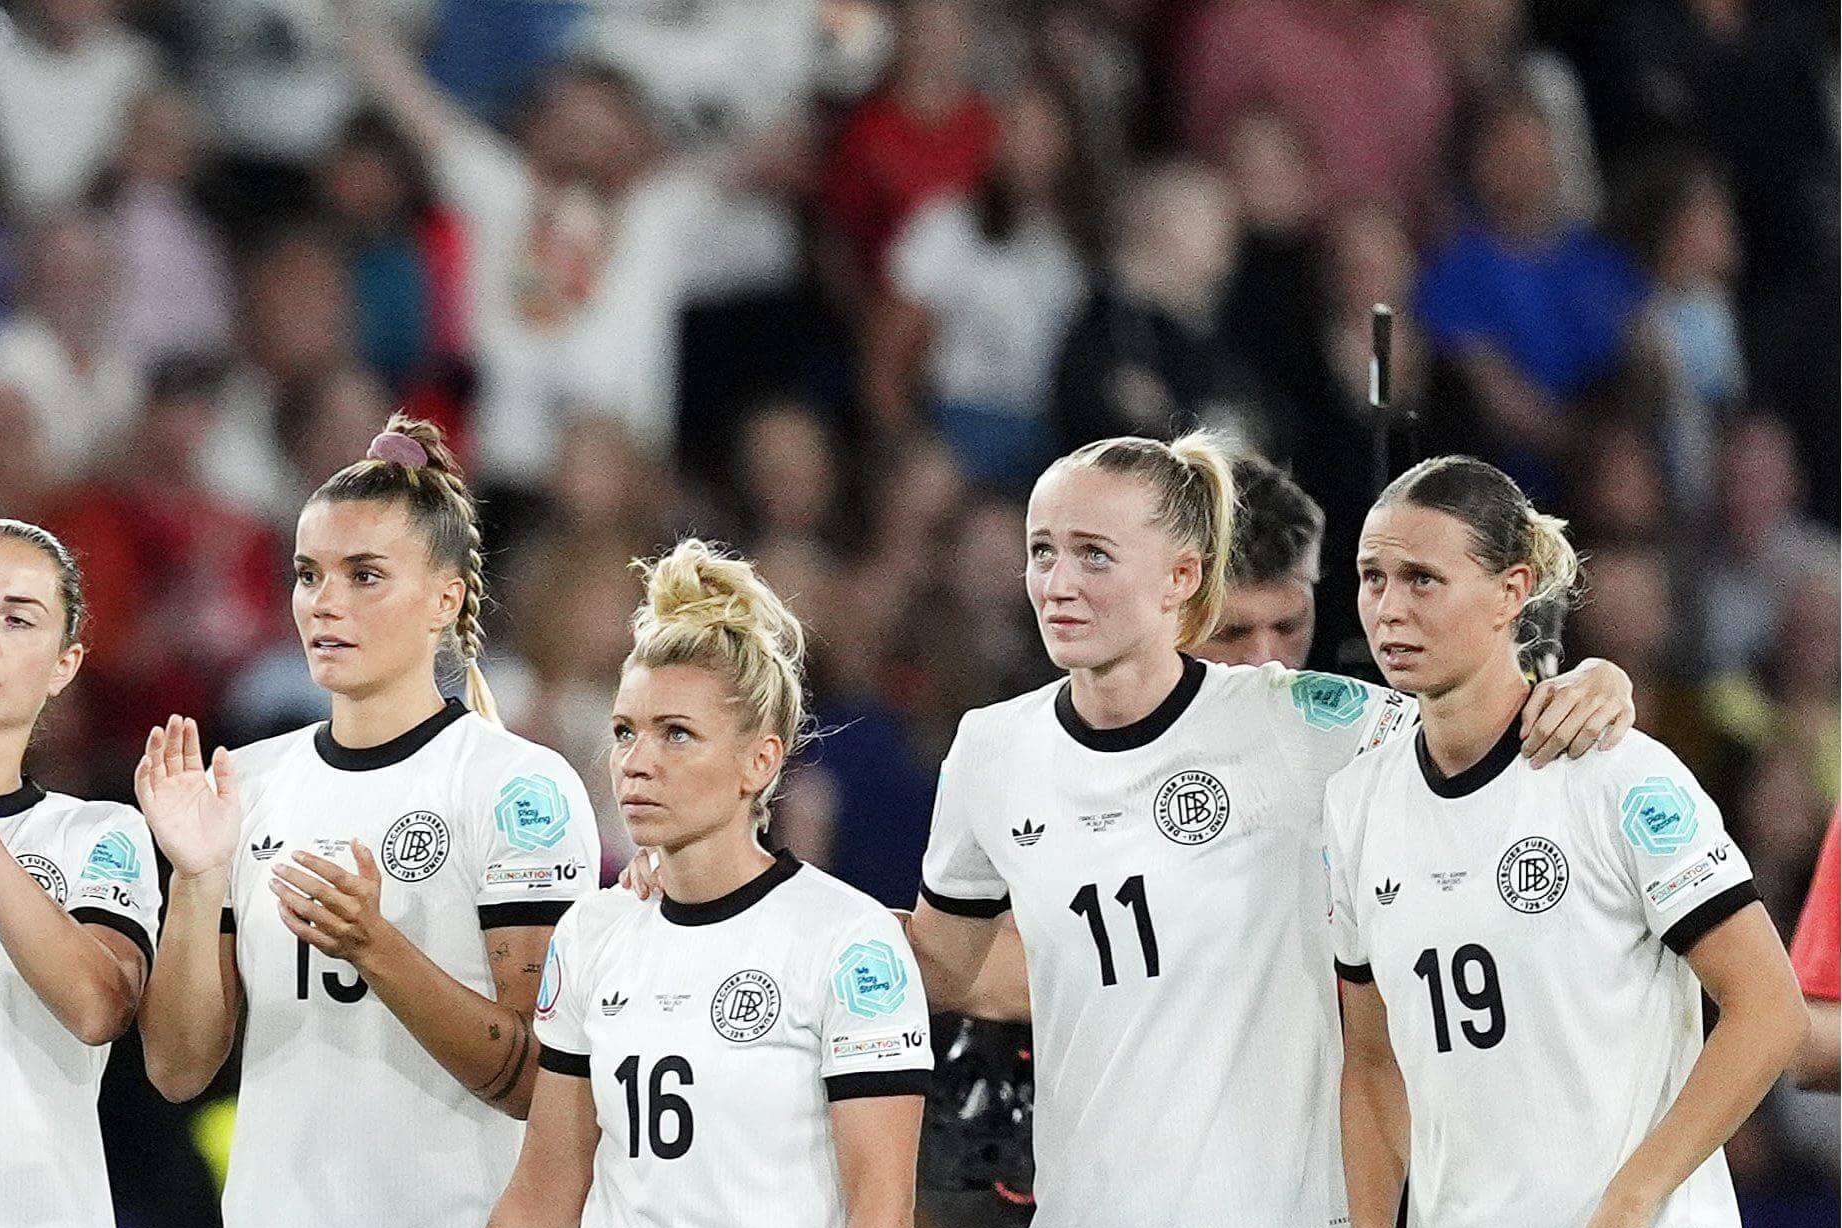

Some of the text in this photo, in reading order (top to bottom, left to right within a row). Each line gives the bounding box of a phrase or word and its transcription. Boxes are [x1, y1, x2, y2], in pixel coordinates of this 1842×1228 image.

[1068, 874, 1160, 987] 11
[1412, 943, 1506, 1053] 19
[613, 1055, 694, 1160] 16
